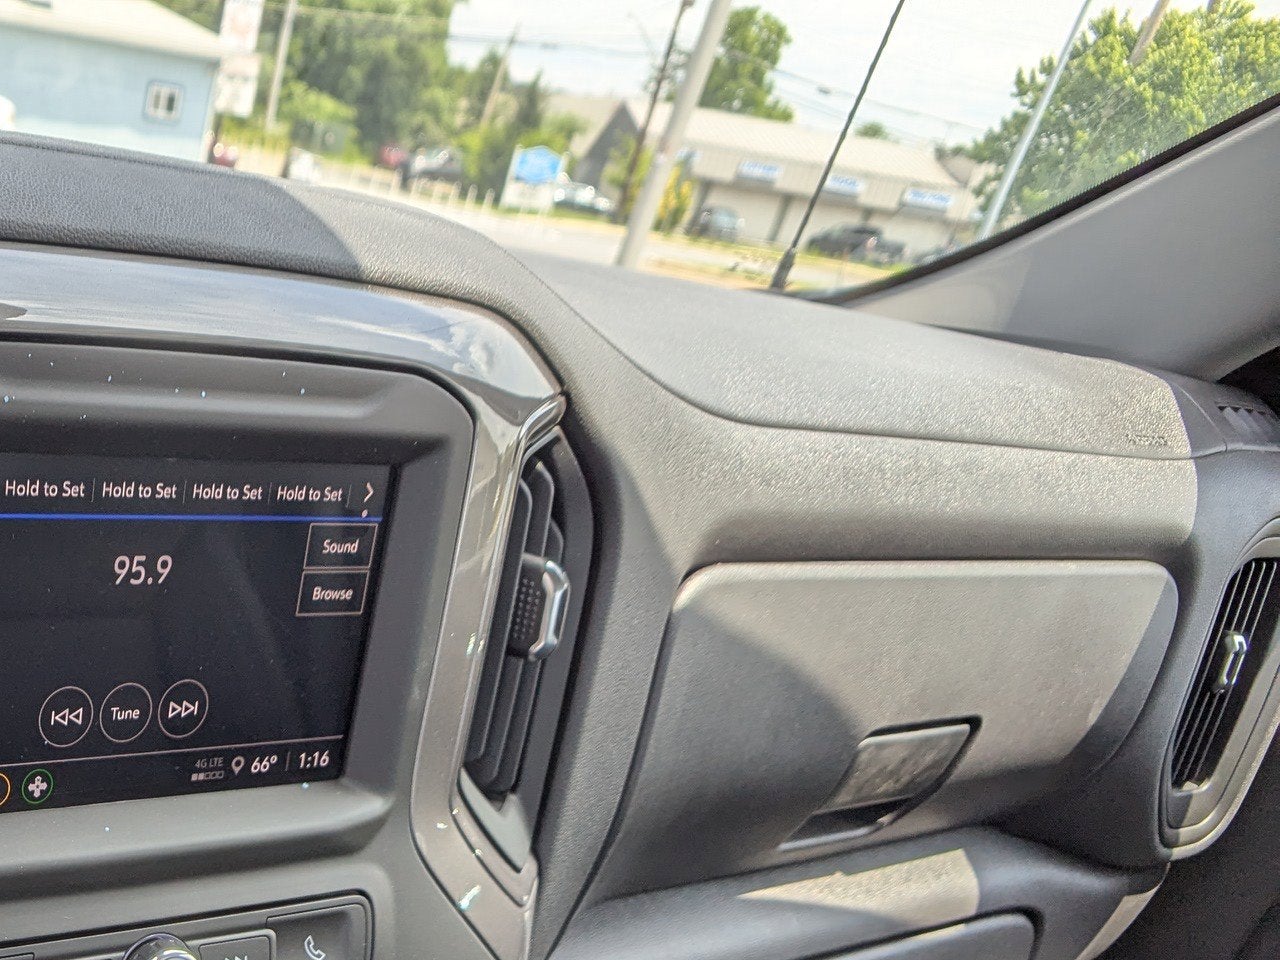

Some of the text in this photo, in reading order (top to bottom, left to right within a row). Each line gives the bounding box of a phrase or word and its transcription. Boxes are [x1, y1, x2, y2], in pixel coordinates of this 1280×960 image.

[5, 479, 85, 497] Hold to Set
[102, 481, 177, 499] Hold to Set
[192, 483, 263, 501] Hold to Set
[276, 485, 343, 502] Hold to Set
[322, 538, 360, 554] Sound
[114, 555, 173, 585] 95.9
[312, 586, 354, 601] Browse
[110, 707, 140, 721] Tune
[195, 757, 224, 768] 4G LTE
[299, 750, 330, 769] 1:16
